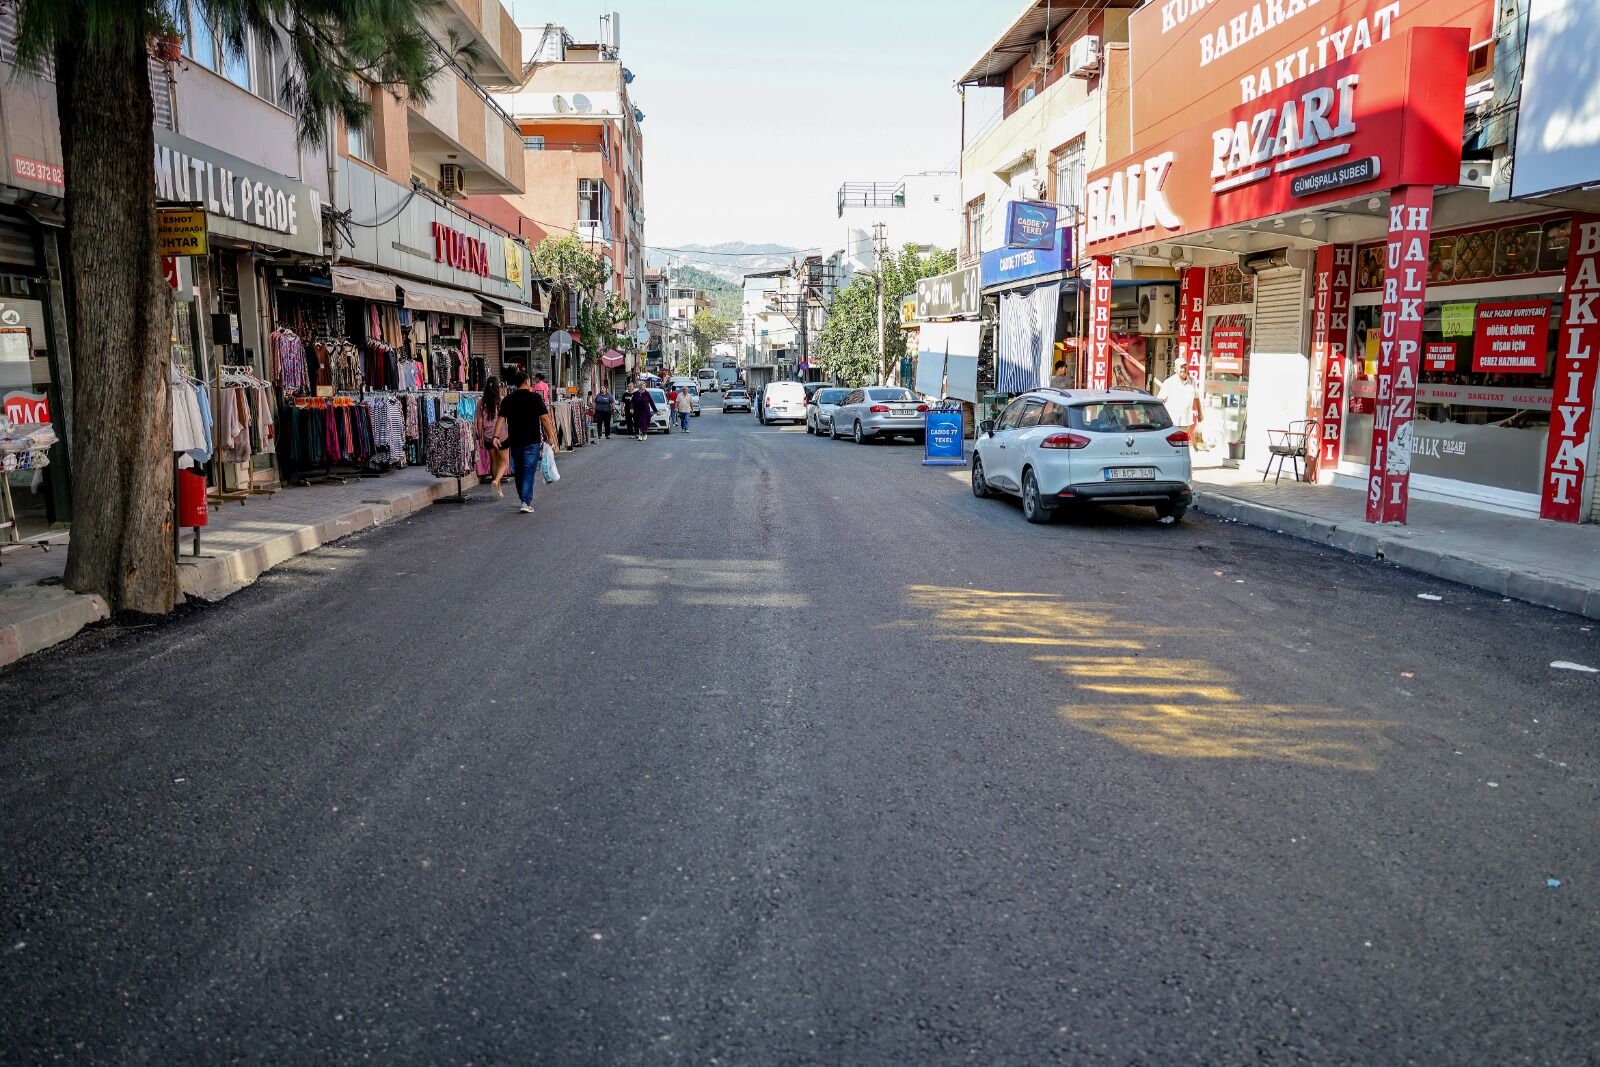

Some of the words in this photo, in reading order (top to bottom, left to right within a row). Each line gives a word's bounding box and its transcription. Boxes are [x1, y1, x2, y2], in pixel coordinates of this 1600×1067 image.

[1200, 0, 1320, 67] BAHARA
[1240, 0, 1400, 104] BAKLİYAT
[16, 159, 36, 177] 0232
[37, 164, 52, 181] 372
[154, 143, 235, 218] MUTLU
[240, 176, 298, 235] PERDE
[1086, 151, 1183, 243] HALK
[1211, 74, 1359, 178] PAZARI
[1294, 172, 1338, 190] GÜMÜŞPALA
[1338, 161, 1368, 184] ŞUBESİ
[161, 237, 198, 248] UHTAR
[163, 216, 193, 224] ESHOT
[432, 222, 490, 278] TUANA
[1018, 217, 1041, 228] CADDE
[1023, 225, 1043, 236] TEKEL
[1331, 249, 1350, 329] HALK
[1399, 208, 1429, 320] HALK
[1094, 266, 1110, 390] KURUYEM
[1370, 205, 1404, 508] KURUYEMİŞ
[1480, 356, 1498, 367] ÇEREZ
[1550, 223, 1600, 504] BAKLİYAT
[1323, 342, 1343, 460] PAZARI
[1110, 469, 1119, 478] 16
[1412, 437, 1440, 458] HALK
[1443, 439, 1466, 453] PAZARI
